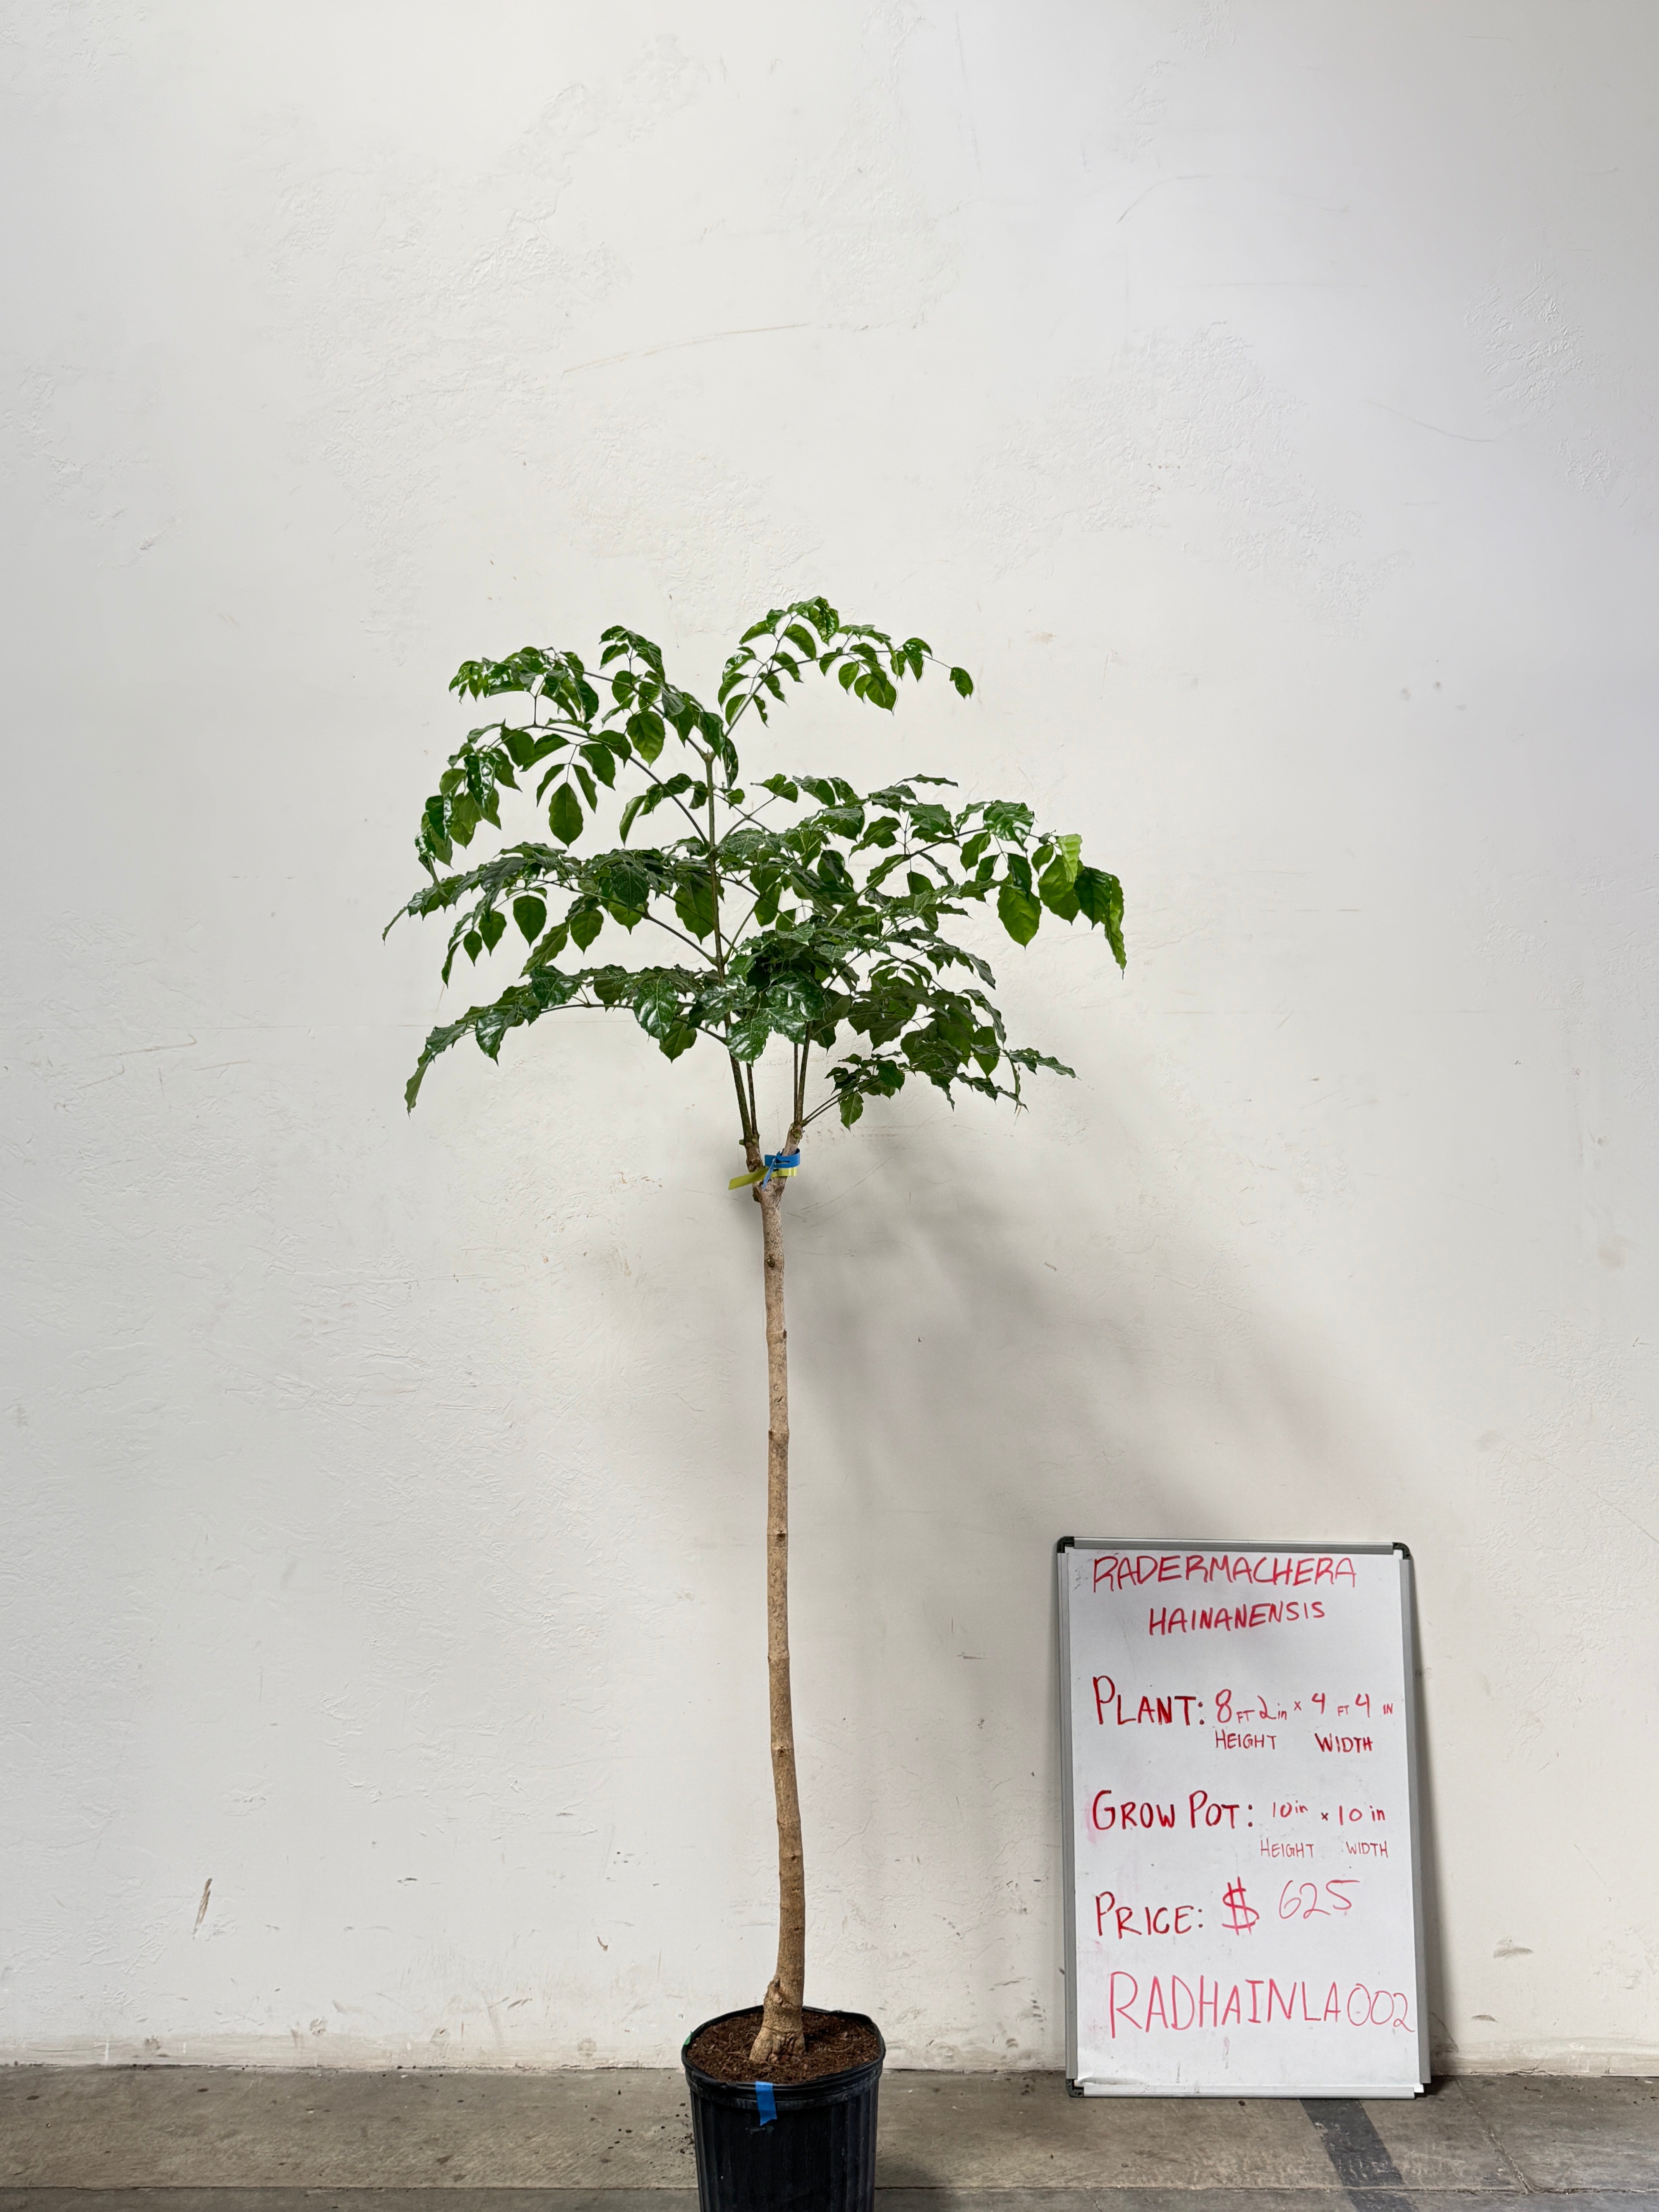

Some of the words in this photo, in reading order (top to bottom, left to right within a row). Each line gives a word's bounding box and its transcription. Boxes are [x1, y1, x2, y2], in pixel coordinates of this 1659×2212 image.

[1093, 1555, 1357, 1592] RADERMACHERA
[1149, 1601, 1325, 1636] HAINANENSIS
[1092, 1675, 1204, 1726] PLANT:
[1311, 1692, 1326, 1714] 4
[1337, 1705, 1350, 1716] FT
[1355, 1694, 1370, 1717] 4
[1215, 1729, 1277, 1750] HEIGHT
[1314, 1733, 1373, 1753] WIDTH
[1092, 1790, 1175, 1830] GROW
[1338, 1805, 1363, 1826] 10
[1261, 1838, 1314, 1858] HEIGHT
[1346, 1841, 1388, 1858] WIDTH
[1095, 1891, 1203, 1939] PRICE:
[1279, 1879, 1360, 1920] 625
